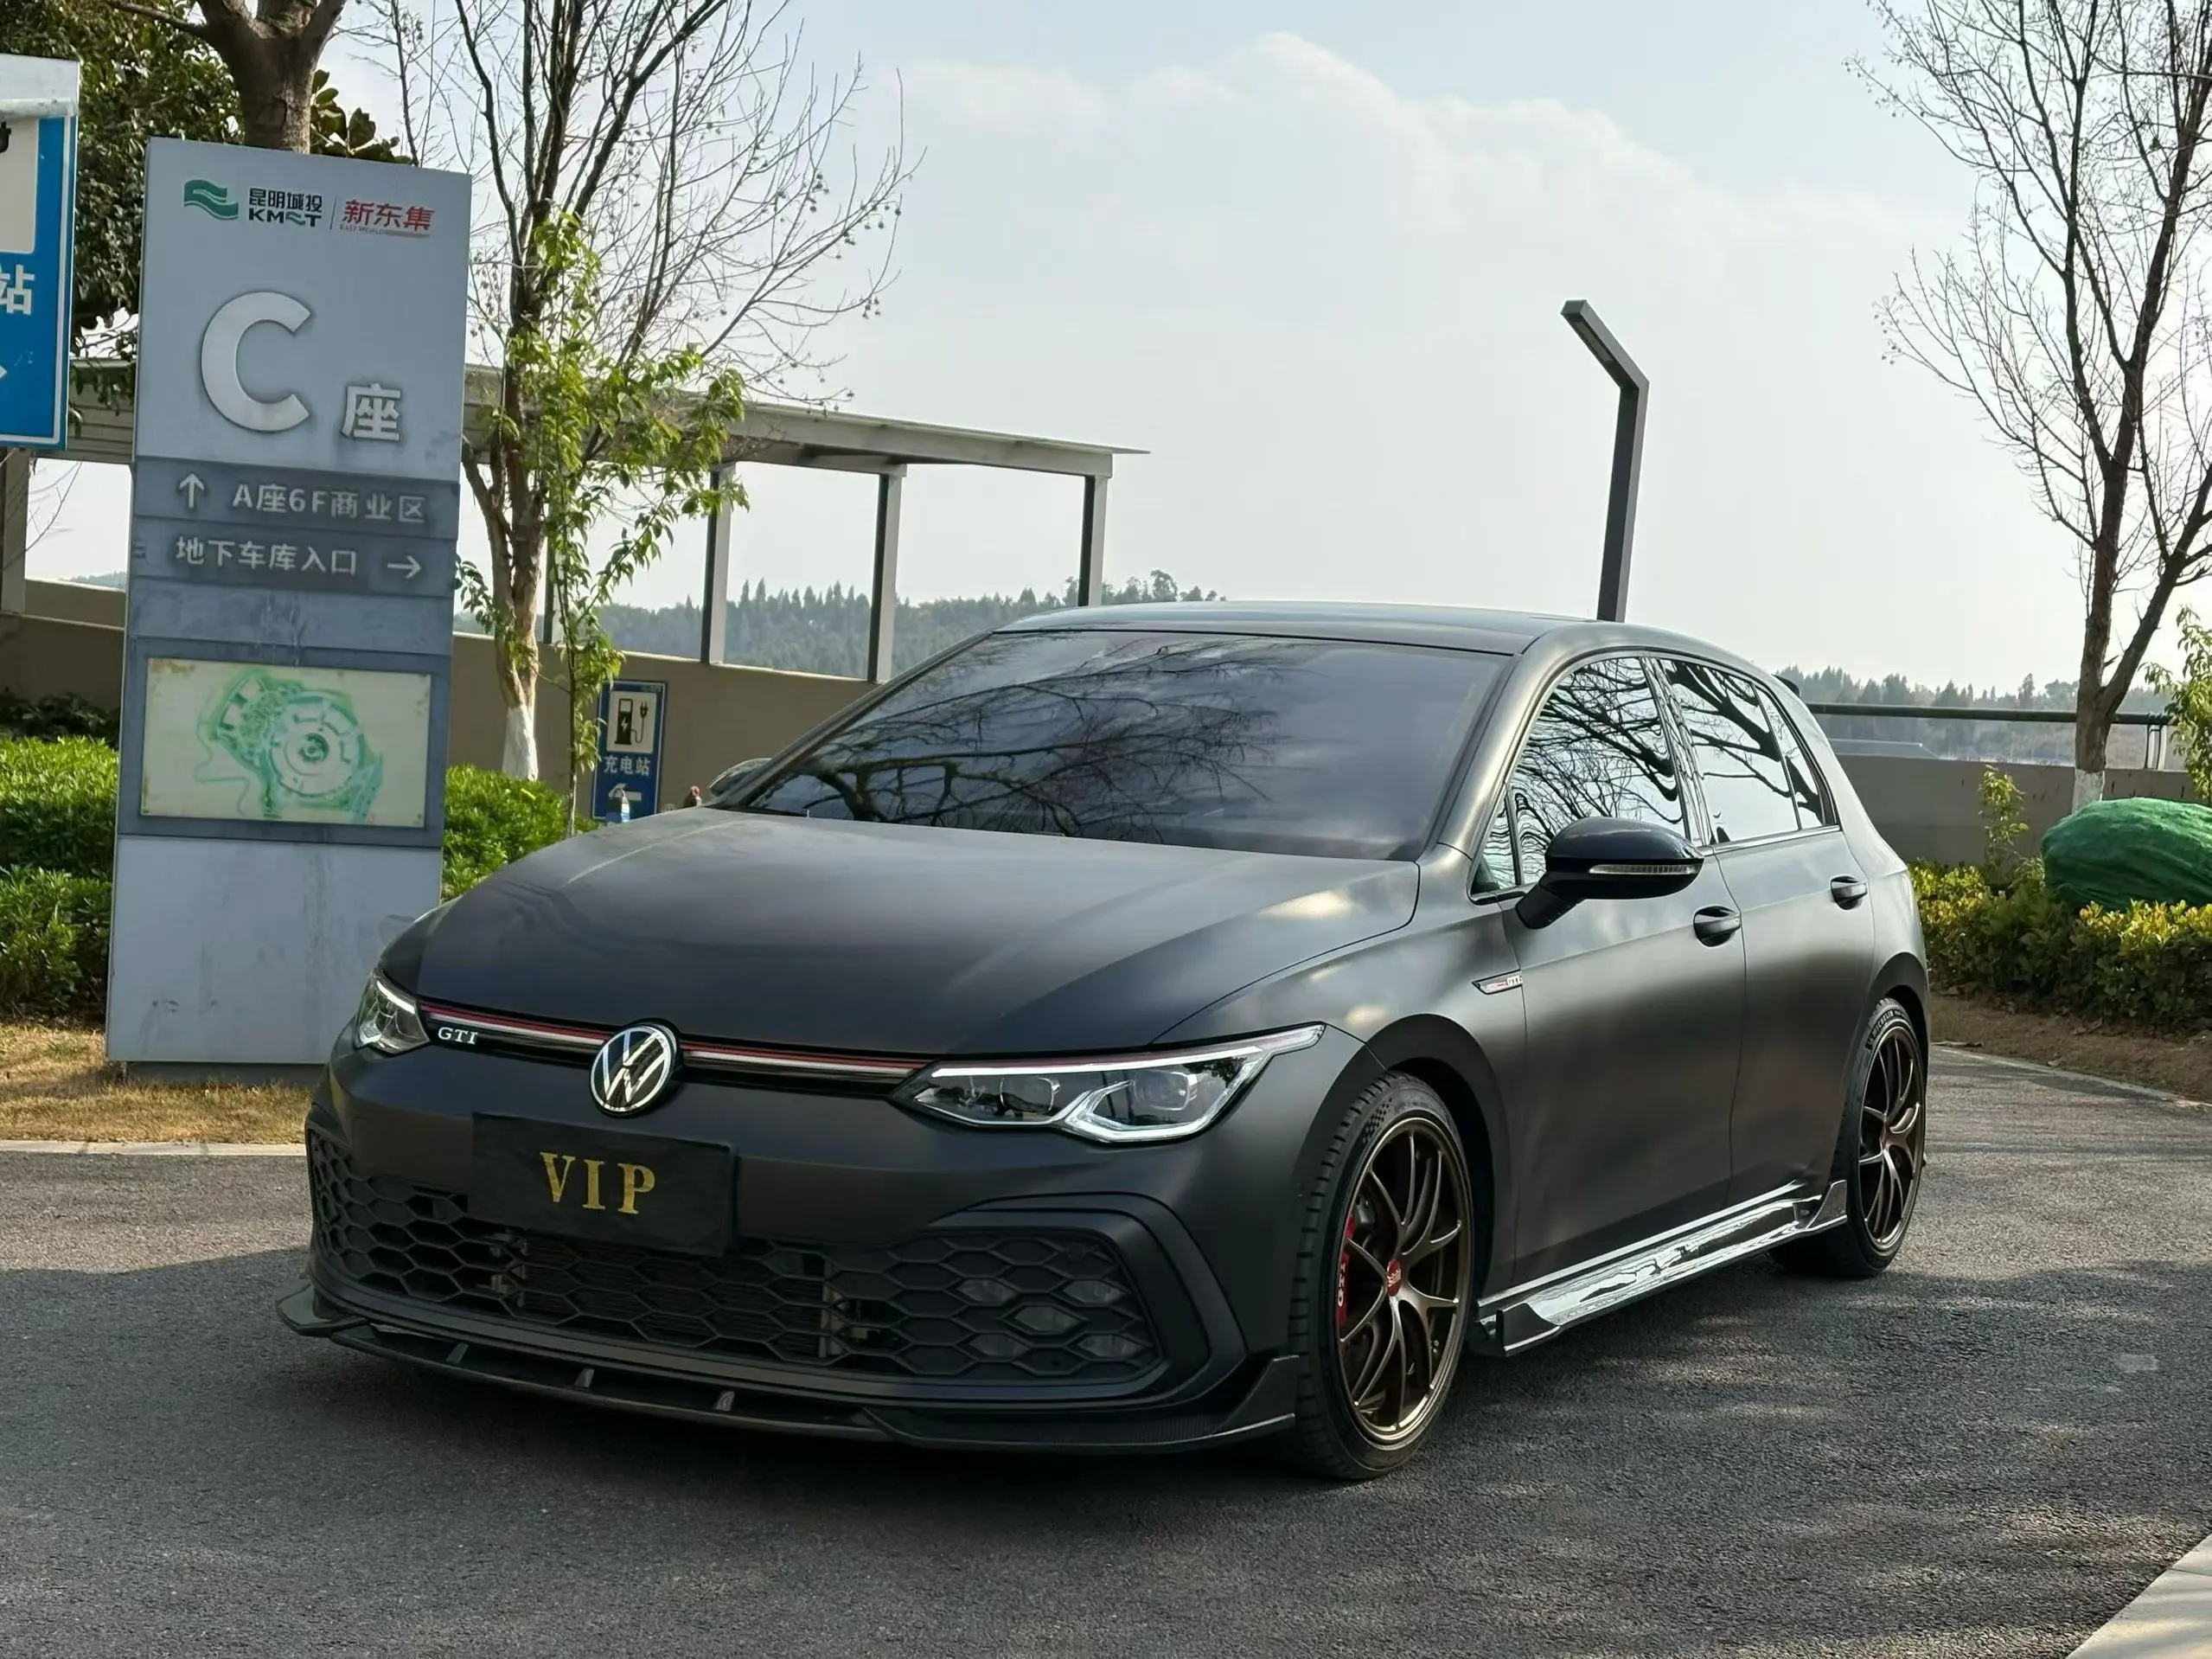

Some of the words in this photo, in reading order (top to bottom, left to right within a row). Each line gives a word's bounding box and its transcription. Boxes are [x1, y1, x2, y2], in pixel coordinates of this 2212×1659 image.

[249, 188, 323, 214] 昆明城投
[342, 199, 434, 231] 新东集
[233, 484, 425, 524] A座6F商业区
[176, 536, 357, 576] 地下车库入口
[604, 755, 651, 776] 充电站
[438, 1027, 479, 1045] GTI
[540, 1152, 655, 1214] VIP
